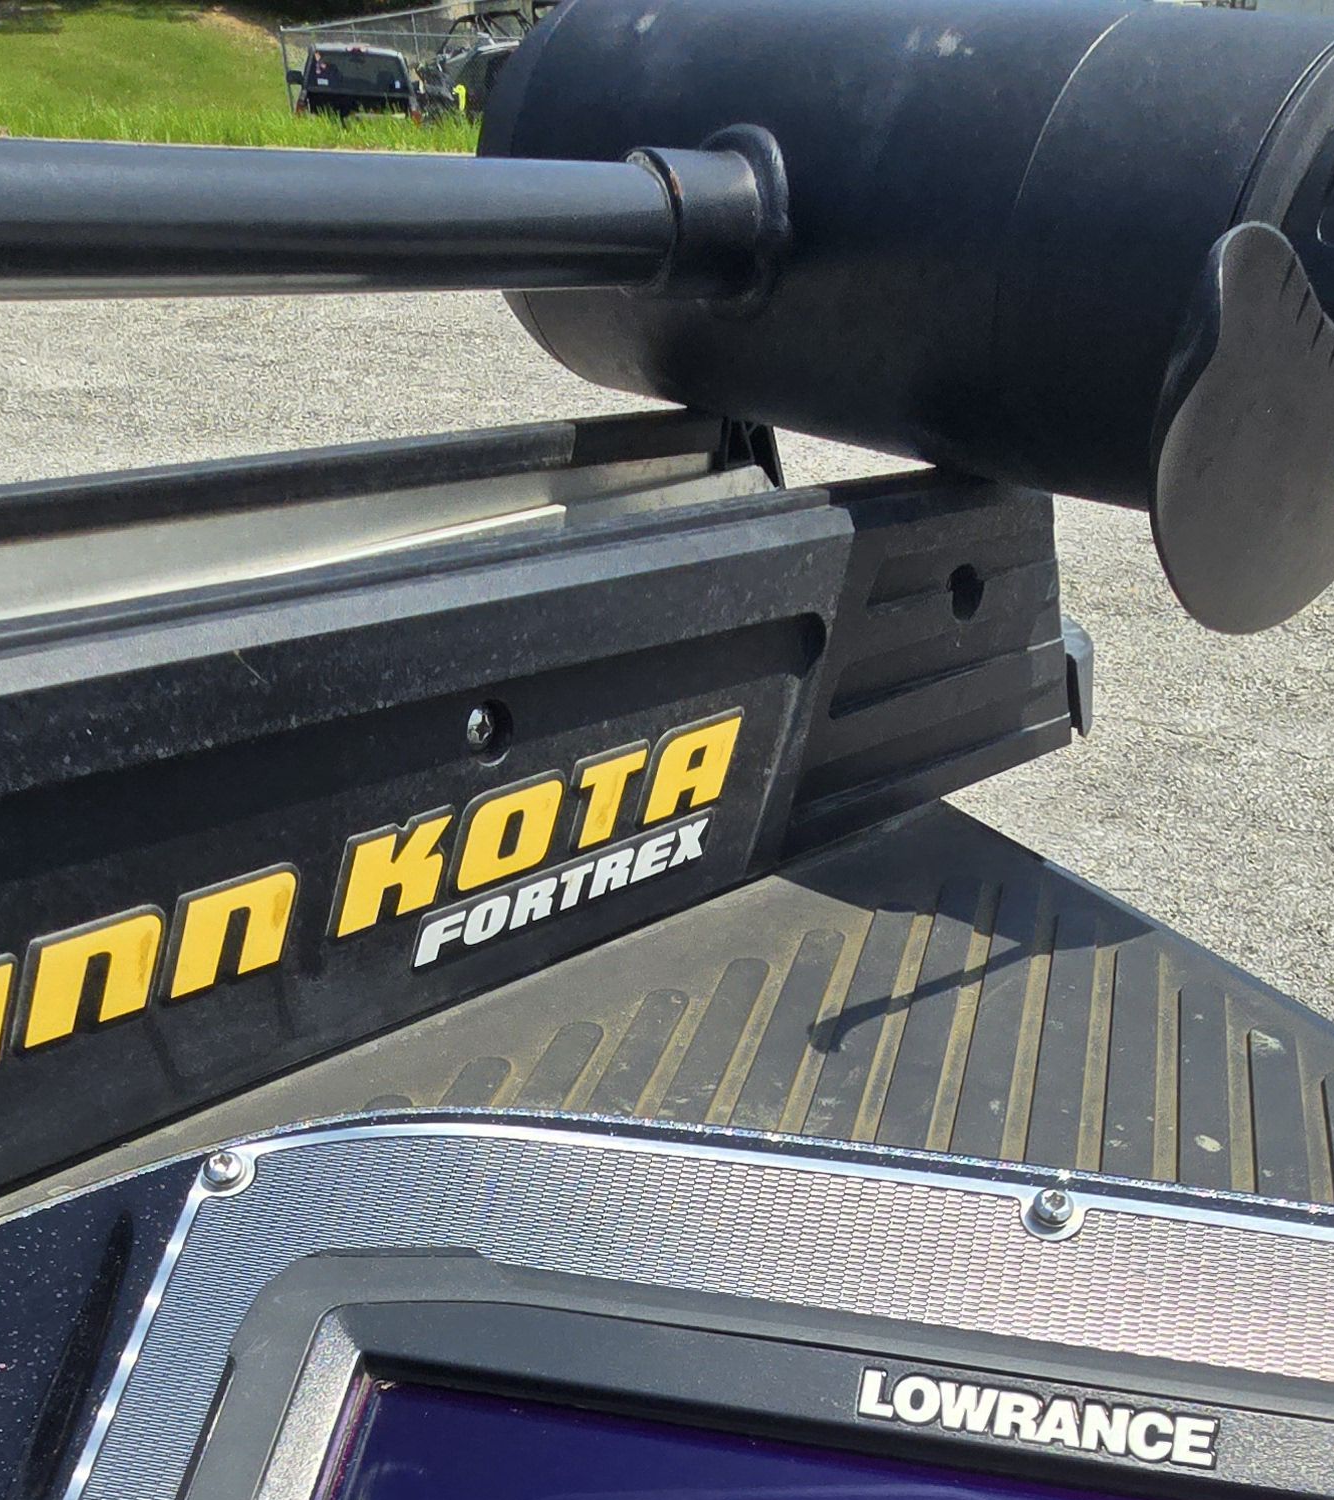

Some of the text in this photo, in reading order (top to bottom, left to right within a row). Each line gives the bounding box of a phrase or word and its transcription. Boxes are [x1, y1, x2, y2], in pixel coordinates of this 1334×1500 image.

[335, 714, 742, 938] KOTA
[413, 816, 709, 968] FORTREX
[857, 1367, 1217, 1468] LOWRANCE
